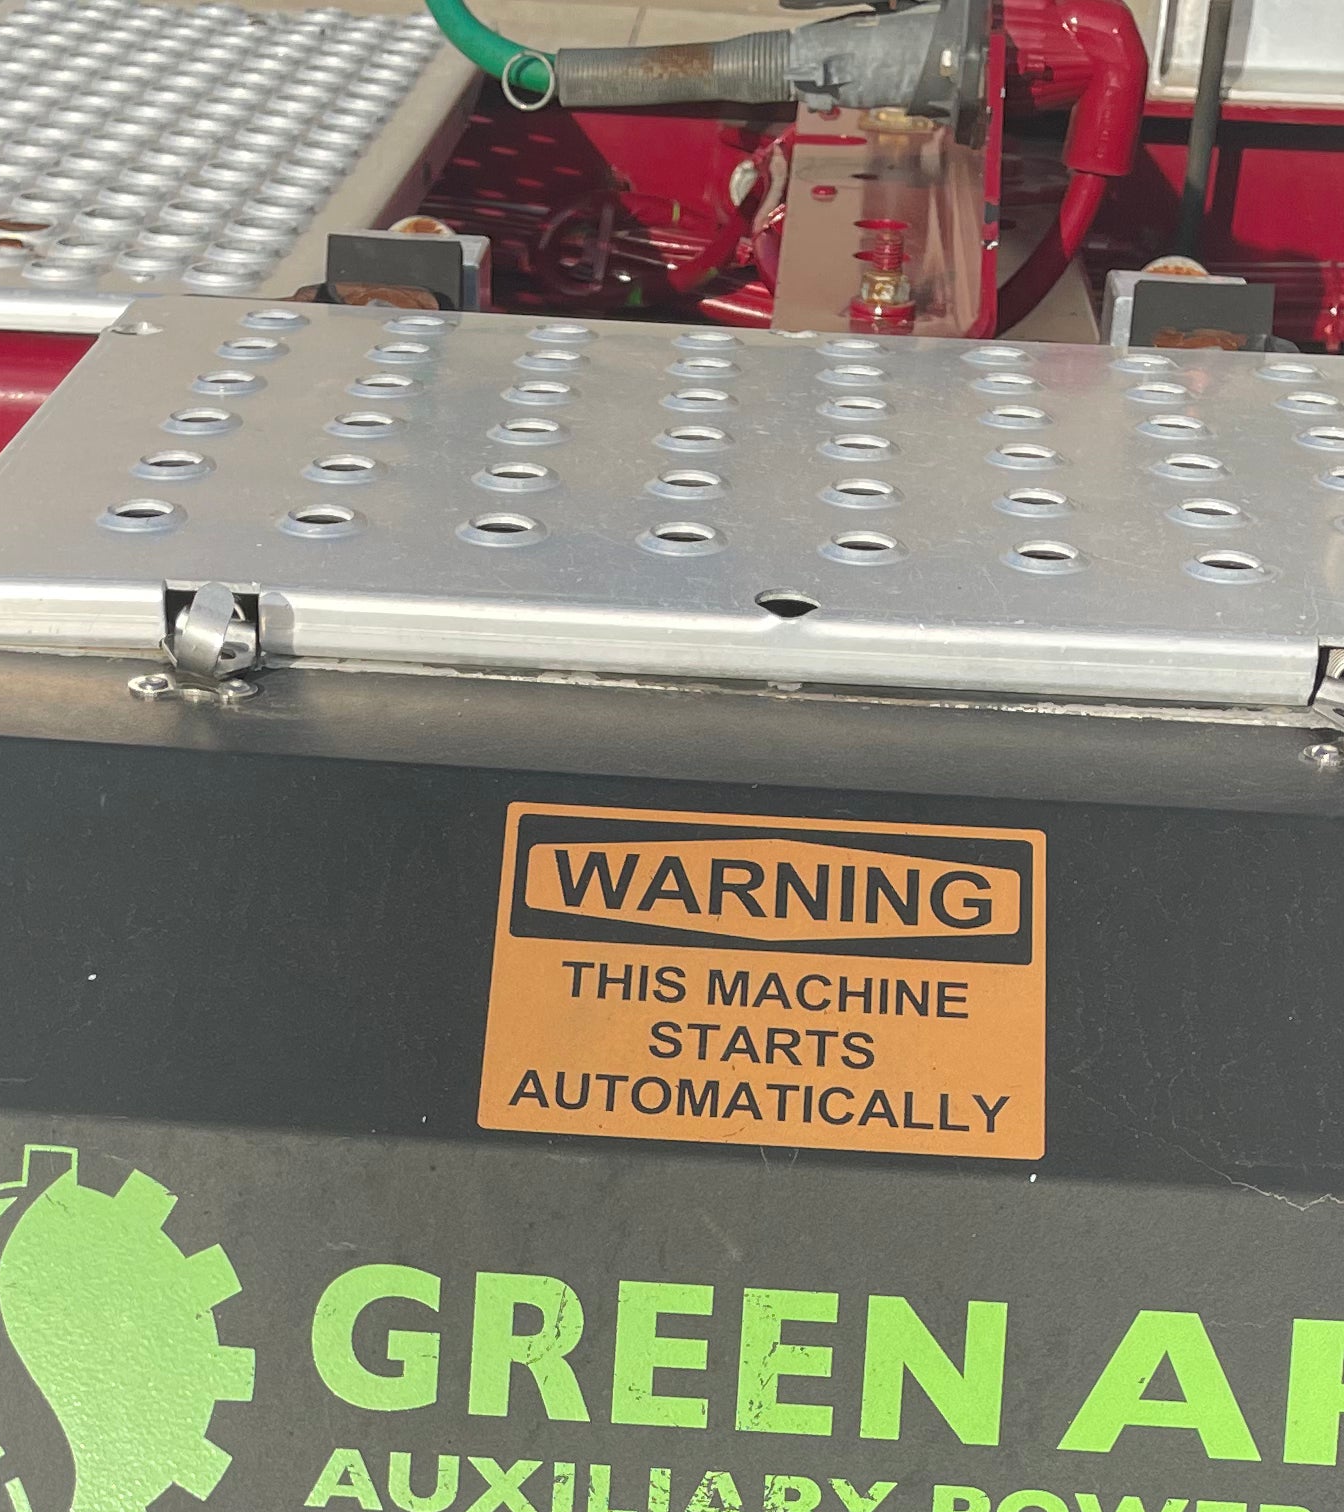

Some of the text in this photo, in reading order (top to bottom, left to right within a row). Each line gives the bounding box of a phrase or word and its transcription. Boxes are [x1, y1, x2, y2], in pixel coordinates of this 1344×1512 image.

[553, 849, 994, 931] WARNING
[562, 960, 970, 1019] THIS MACHINE
[648, 1021, 875, 1070] STARTS
[508, 1069, 1010, 1133] AUTOMATICALLY
[310, 1262, 1008, 1447] GREEN
